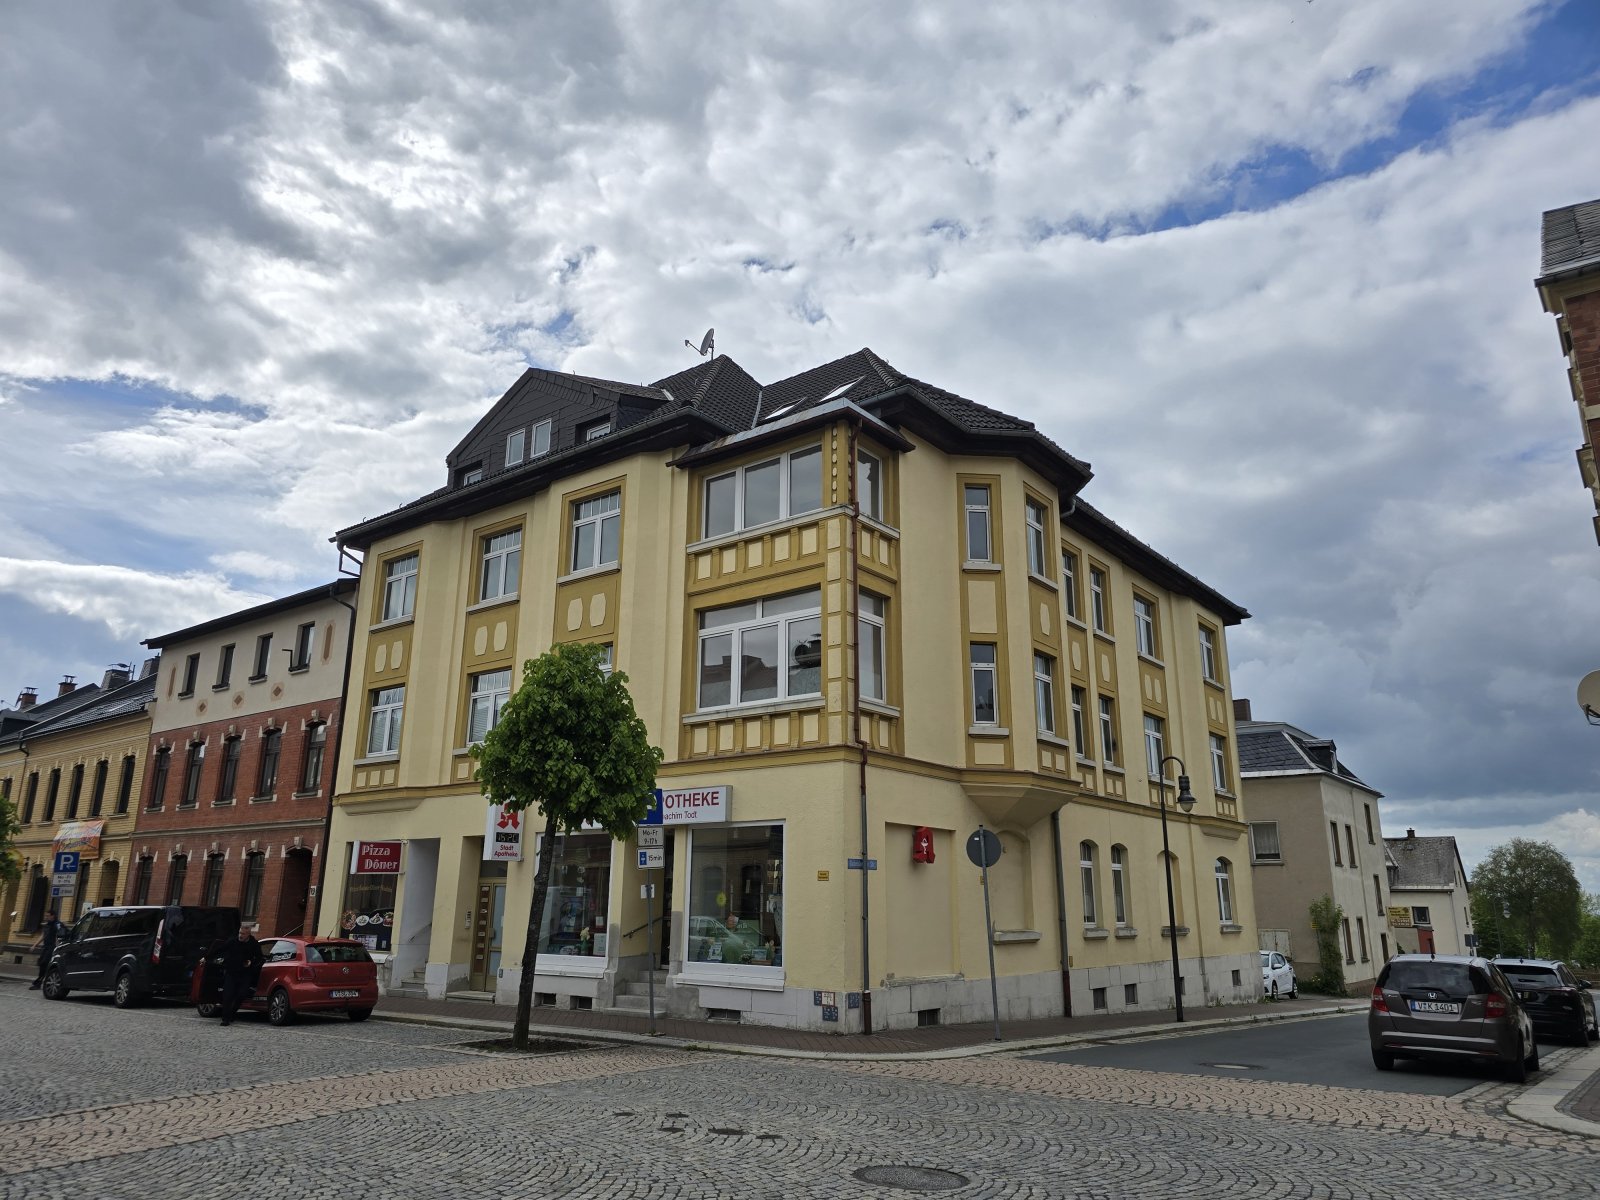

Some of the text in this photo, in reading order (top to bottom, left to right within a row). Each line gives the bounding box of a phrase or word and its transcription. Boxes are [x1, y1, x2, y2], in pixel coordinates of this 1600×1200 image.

[663, 791, 719, 808] OTHEKE
[664, 812, 682, 820] achim
[362, 844, 390, 855] Pizza
[60, 855, 73, 870] P
[365, 859, 398, 869] Döner
[1435, 1003, 1454, 1011] 1401
